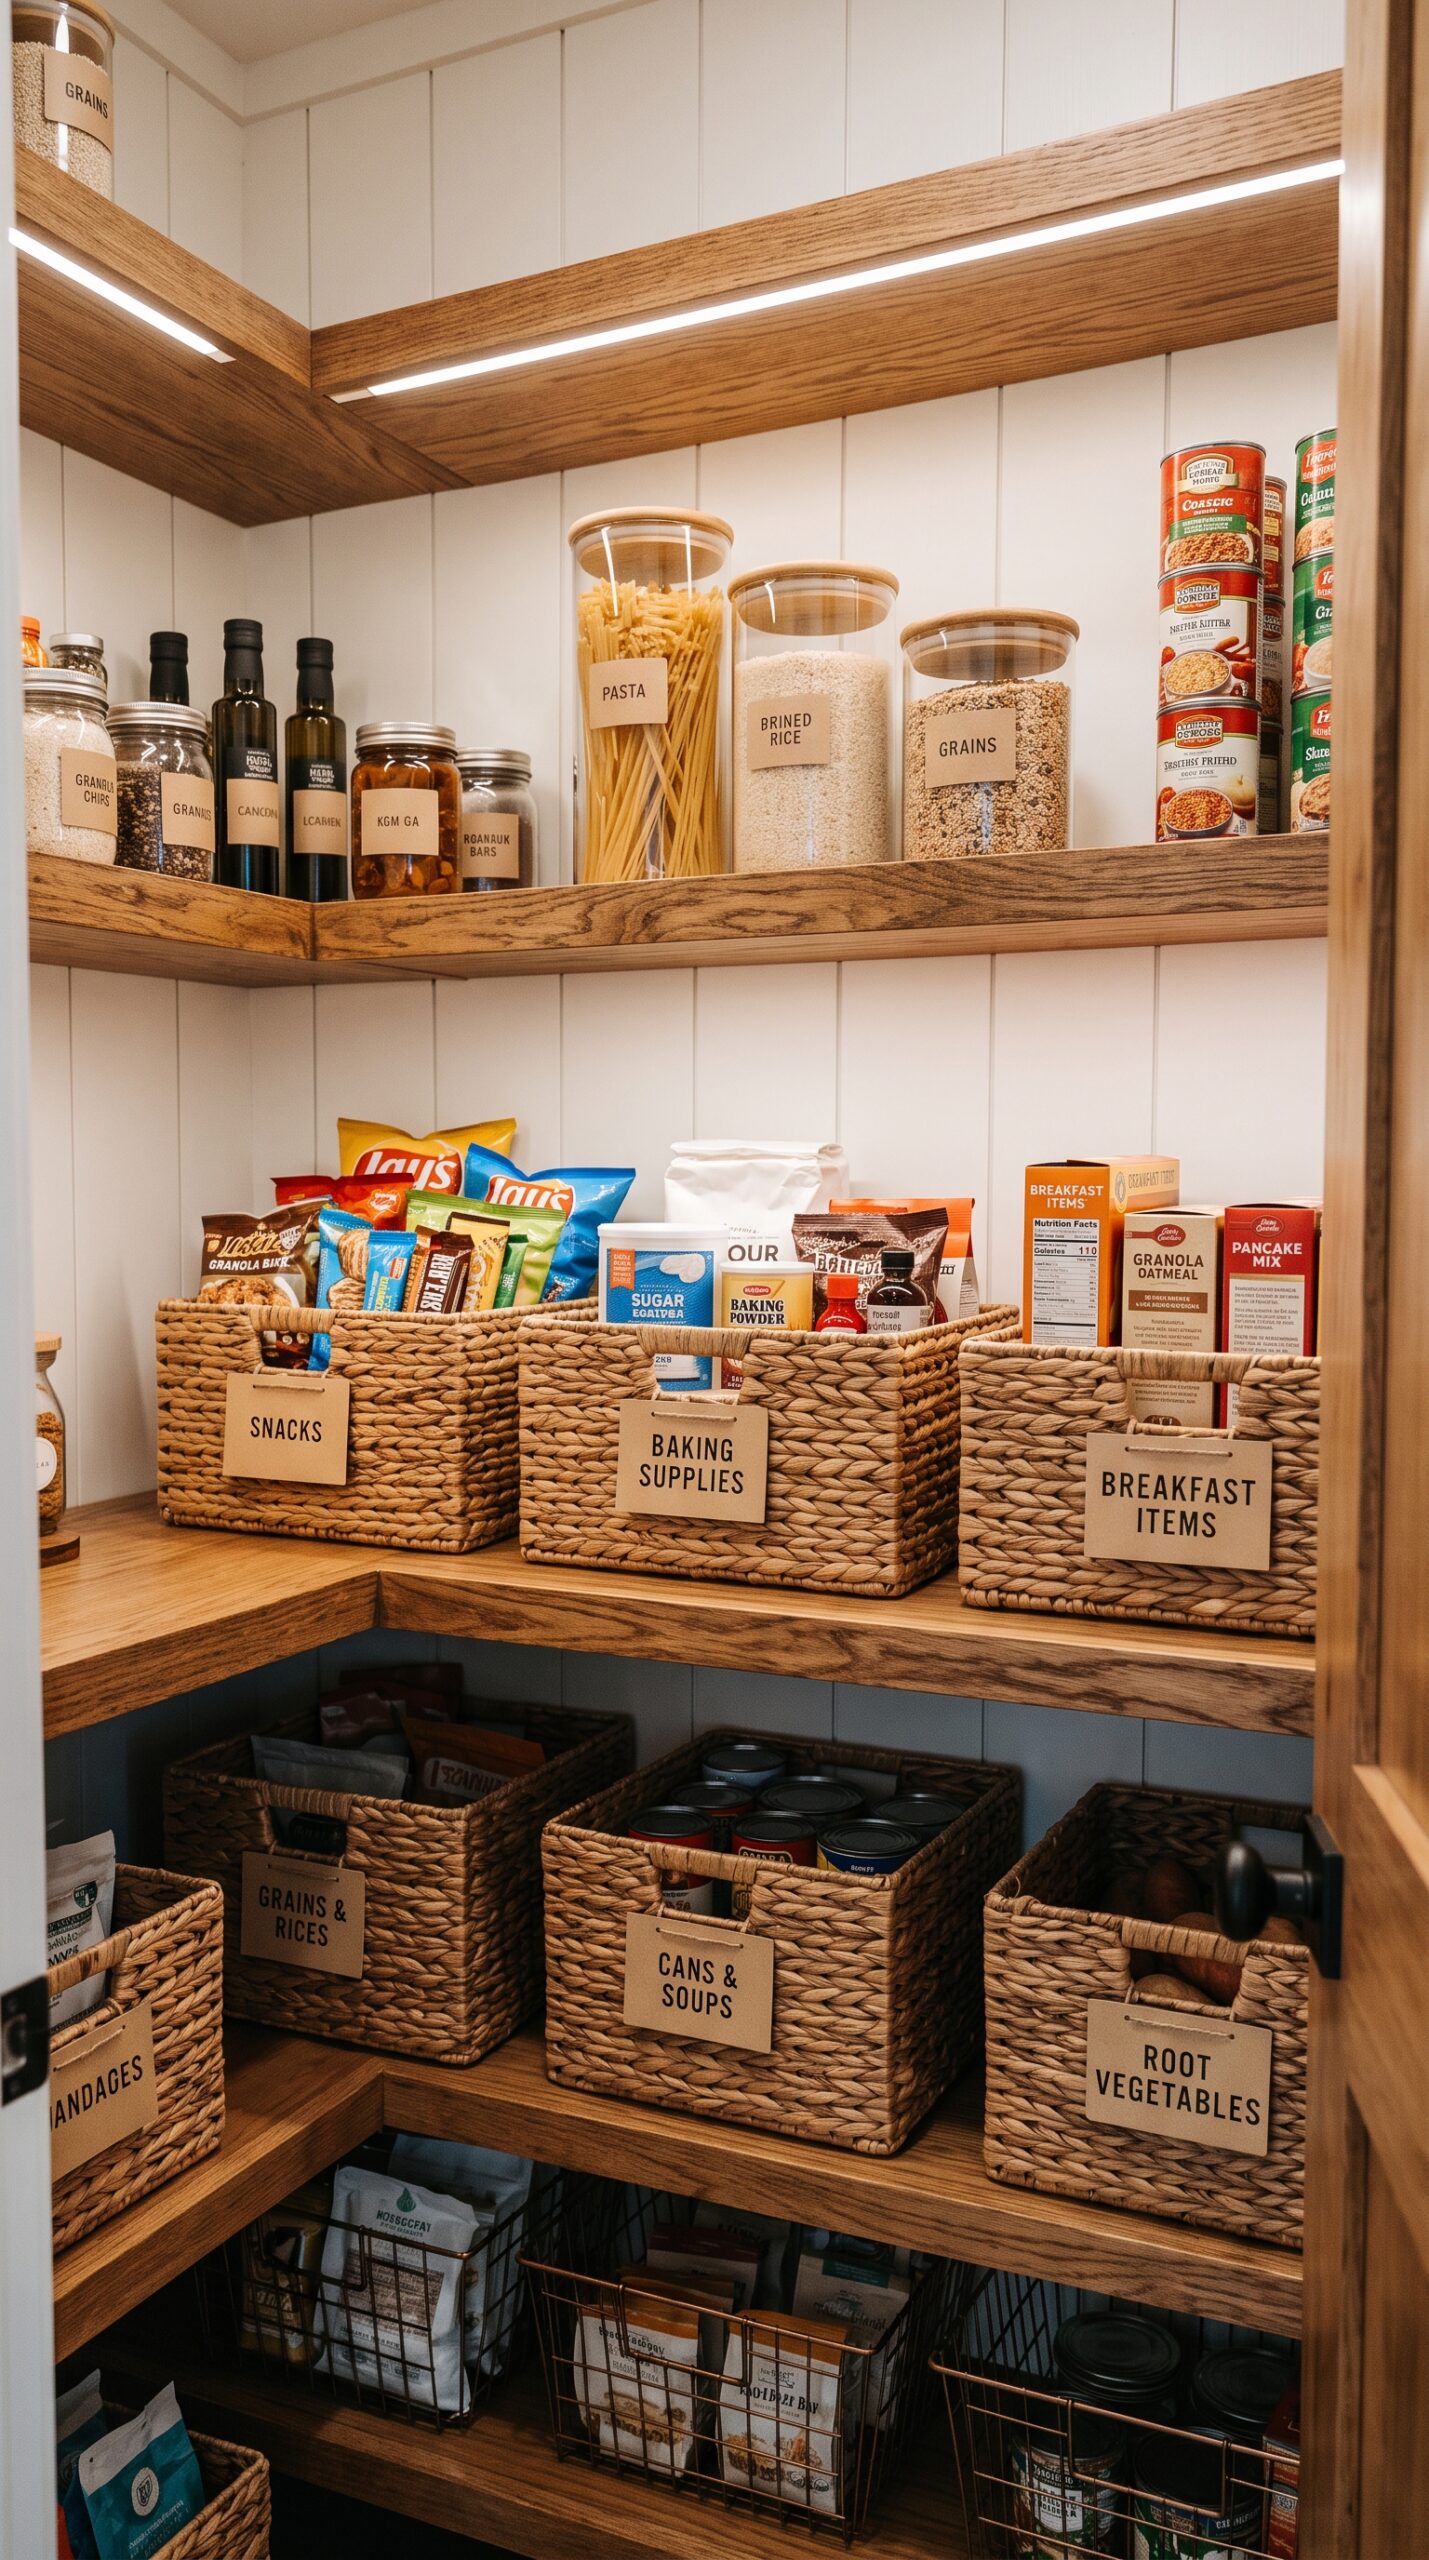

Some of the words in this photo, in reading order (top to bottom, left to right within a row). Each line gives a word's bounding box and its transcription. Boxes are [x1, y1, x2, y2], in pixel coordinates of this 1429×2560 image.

[65, 81, 108, 119] GRAINS
[602, 683, 646, 701] PASTA
[760, 712, 812, 731] BRINED
[770, 730, 801, 746] RICE
[939, 737, 997, 757] GRAINS
[404, 816, 419, 827] GA
[470, 846, 497, 857] BARS
[1030, 1184, 1104, 1196] BREAKFAST
[1047, 1197, 1086, 1209] ITEMS
[1034, 1219, 1071, 1228] Nutrition
[1073, 1220, 1098, 1228] Facts
[1232, 1241, 1303, 1255] PANCAKE
[208, 1259, 260, 1271] GRANOLA
[1133, 1253, 1204, 1268] GRANOLA
[1252, 1255, 1282, 1268] MIX
[1138, 1267, 1198, 1280] OATMEAL
[631, 1292, 685, 1308] SUGAR
[731, 1298, 784, 1312] BAKING
[730, 1312, 785, 1325] POWDER
[250, 1416, 322, 1443] SNACKS
[652, 1433, 733, 1462] BAKING
[639, 1463, 744, 1495] SUPPLIES
[1102, 1471, 1256, 1506] BREAKFAST
[1137, 1507, 1217, 1538] ITEMS
[259, 1885, 327, 1918] GRAINS
[334, 1898, 347, 1923] &
[275, 1915, 328, 1947] RICES
[658, 1951, 715, 1985] CANS
[723, 1964, 738, 1990] &
[661, 1983, 732, 2019] SOUPS
[1143, 2044, 1211, 2081] ROOT
[50, 2054, 143, 2132] ANDAGES
[1096, 2068, 1261, 2126] VEGETABLES
